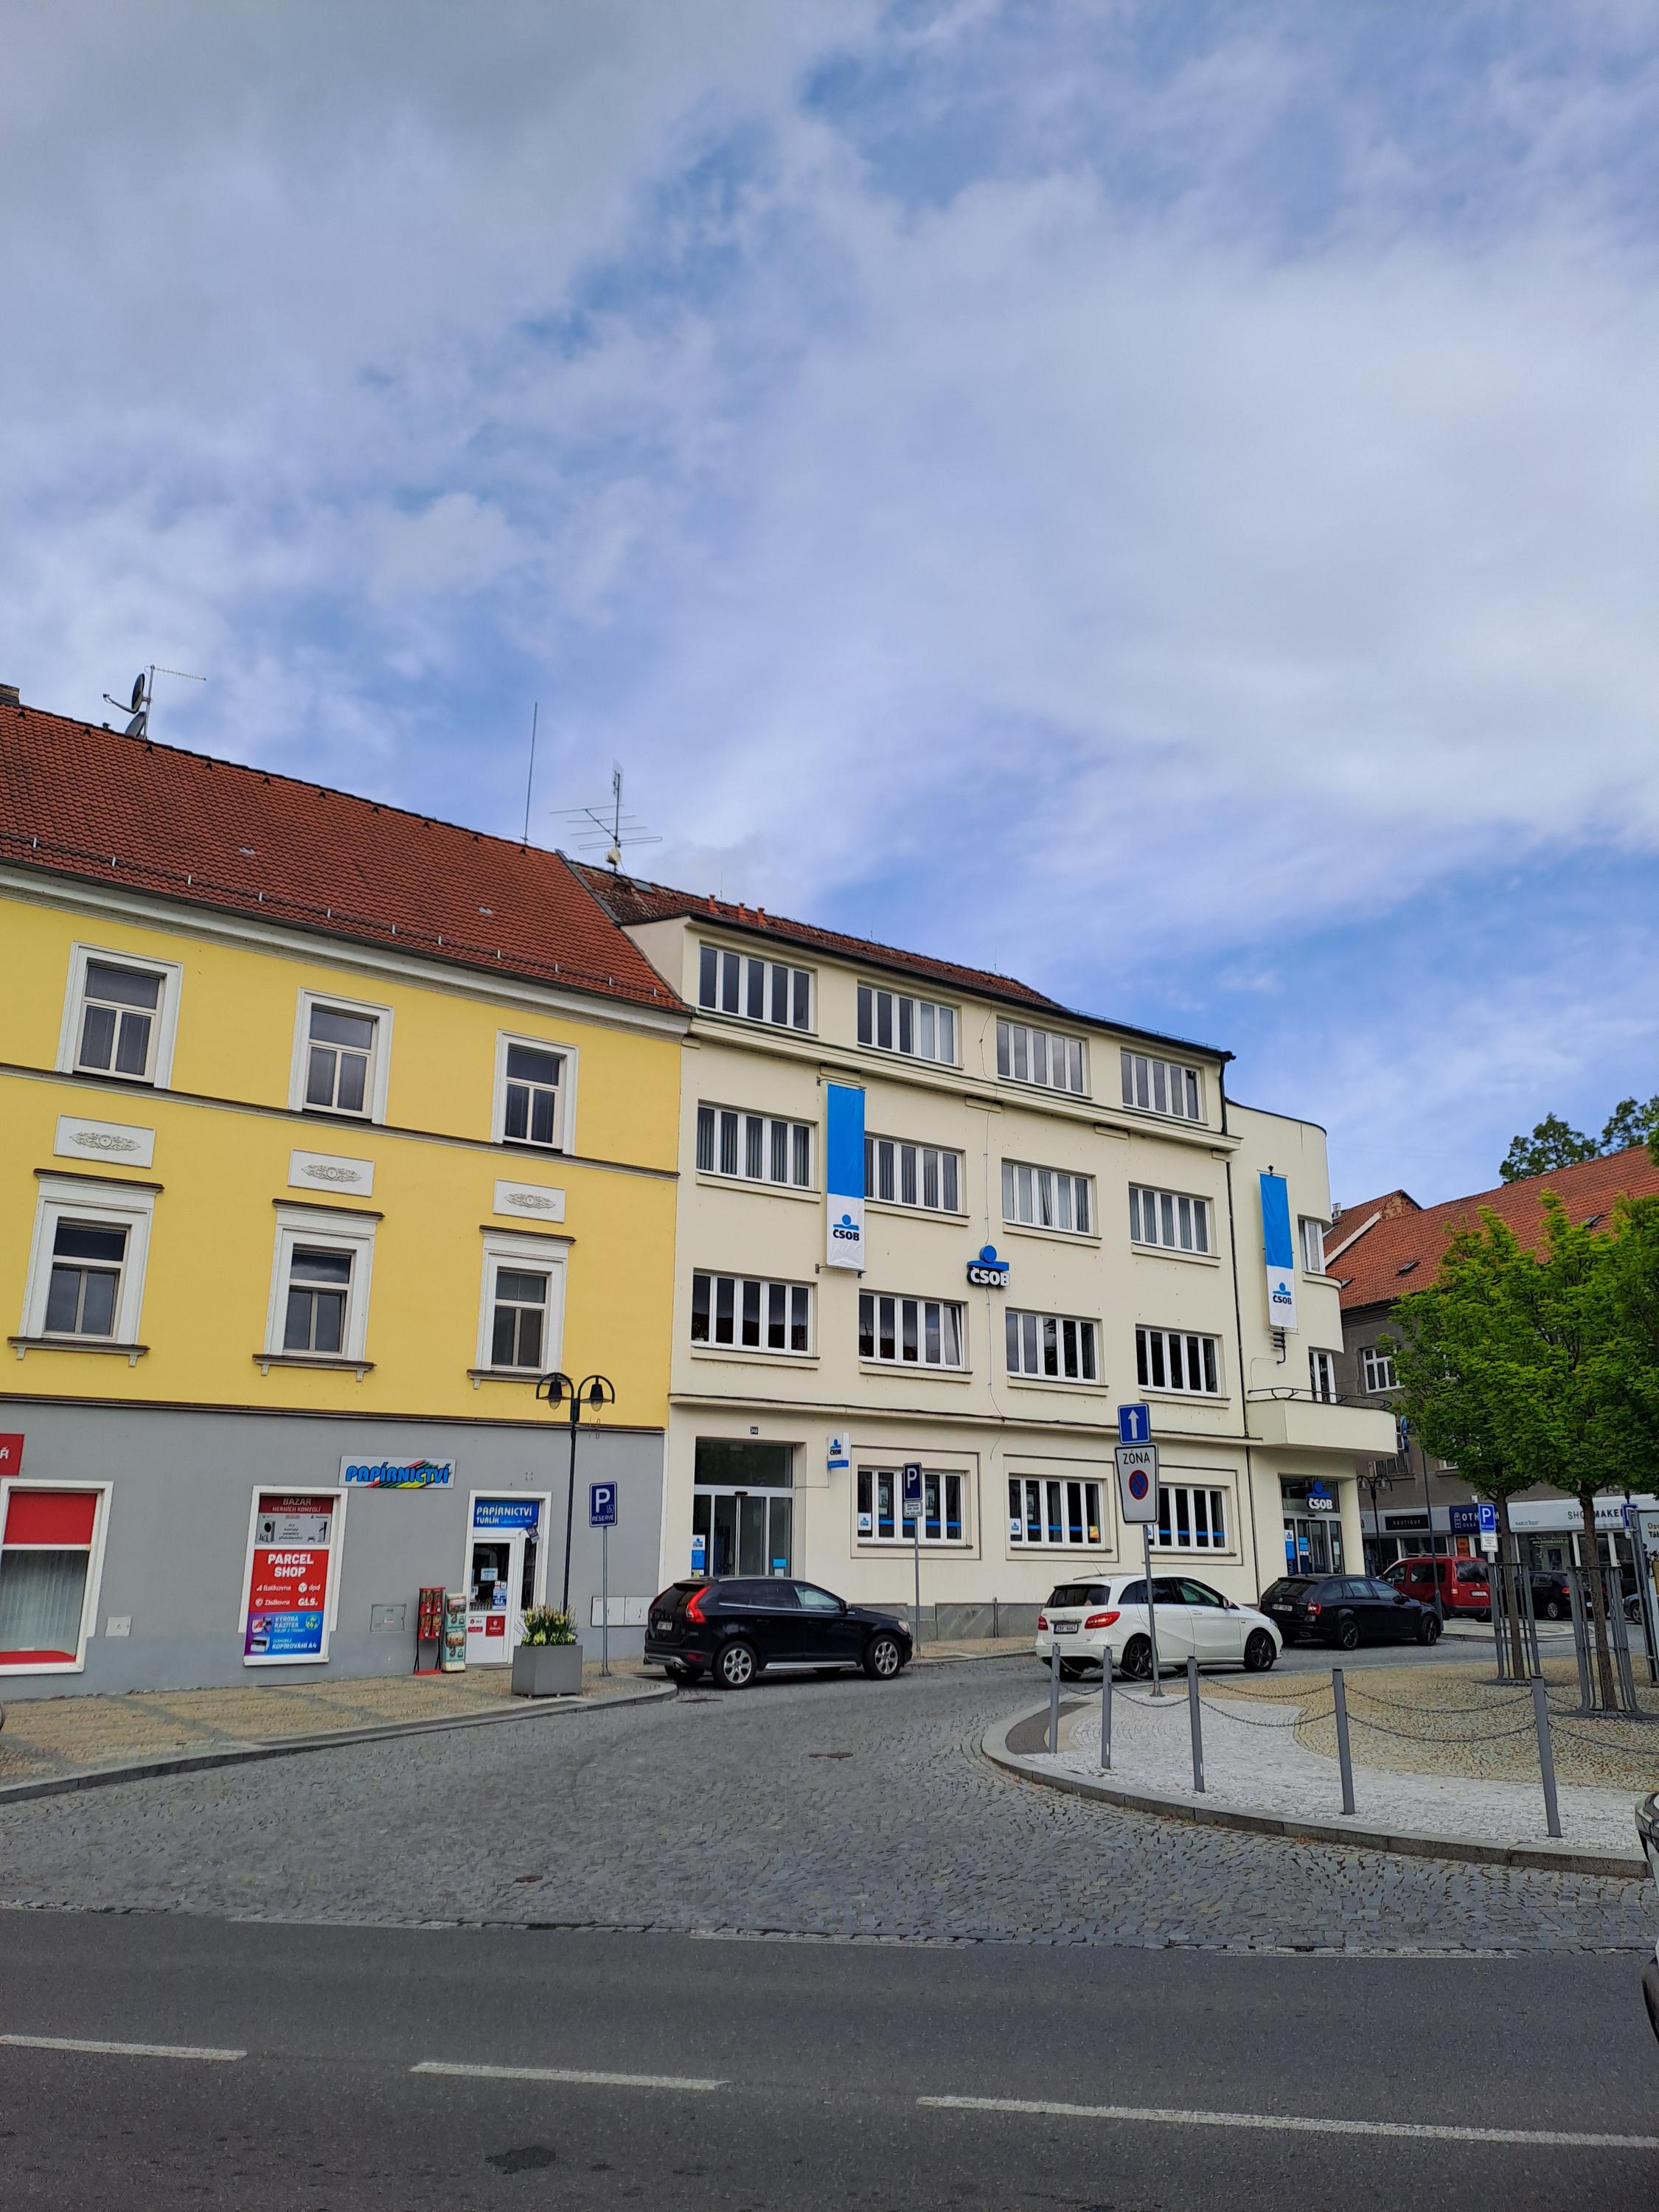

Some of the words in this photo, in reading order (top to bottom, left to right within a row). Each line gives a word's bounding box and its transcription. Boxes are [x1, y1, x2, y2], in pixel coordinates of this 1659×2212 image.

[832, 1228, 860, 1241] ČSOB
[970, 1267, 1010, 1287] ČSOB
[1122, 1450, 1150, 1465] ZÓNA
[345, 1461, 451, 1484] PAPÍRNICTVÍ
[907, 1467, 917, 1489] P
[283, 1498, 312, 1506] BAZAR
[596, 1488, 611, 1513] P
[1309, 1497, 1333, 1509] ČSOB
[476, 1505, 532, 1517] PAPÍRNICTVÍ
[1482, 1508, 1492, 1523] P
[268, 1554, 314, 1565] PARCEL
[274, 1567, 306, 1578] SHOP
